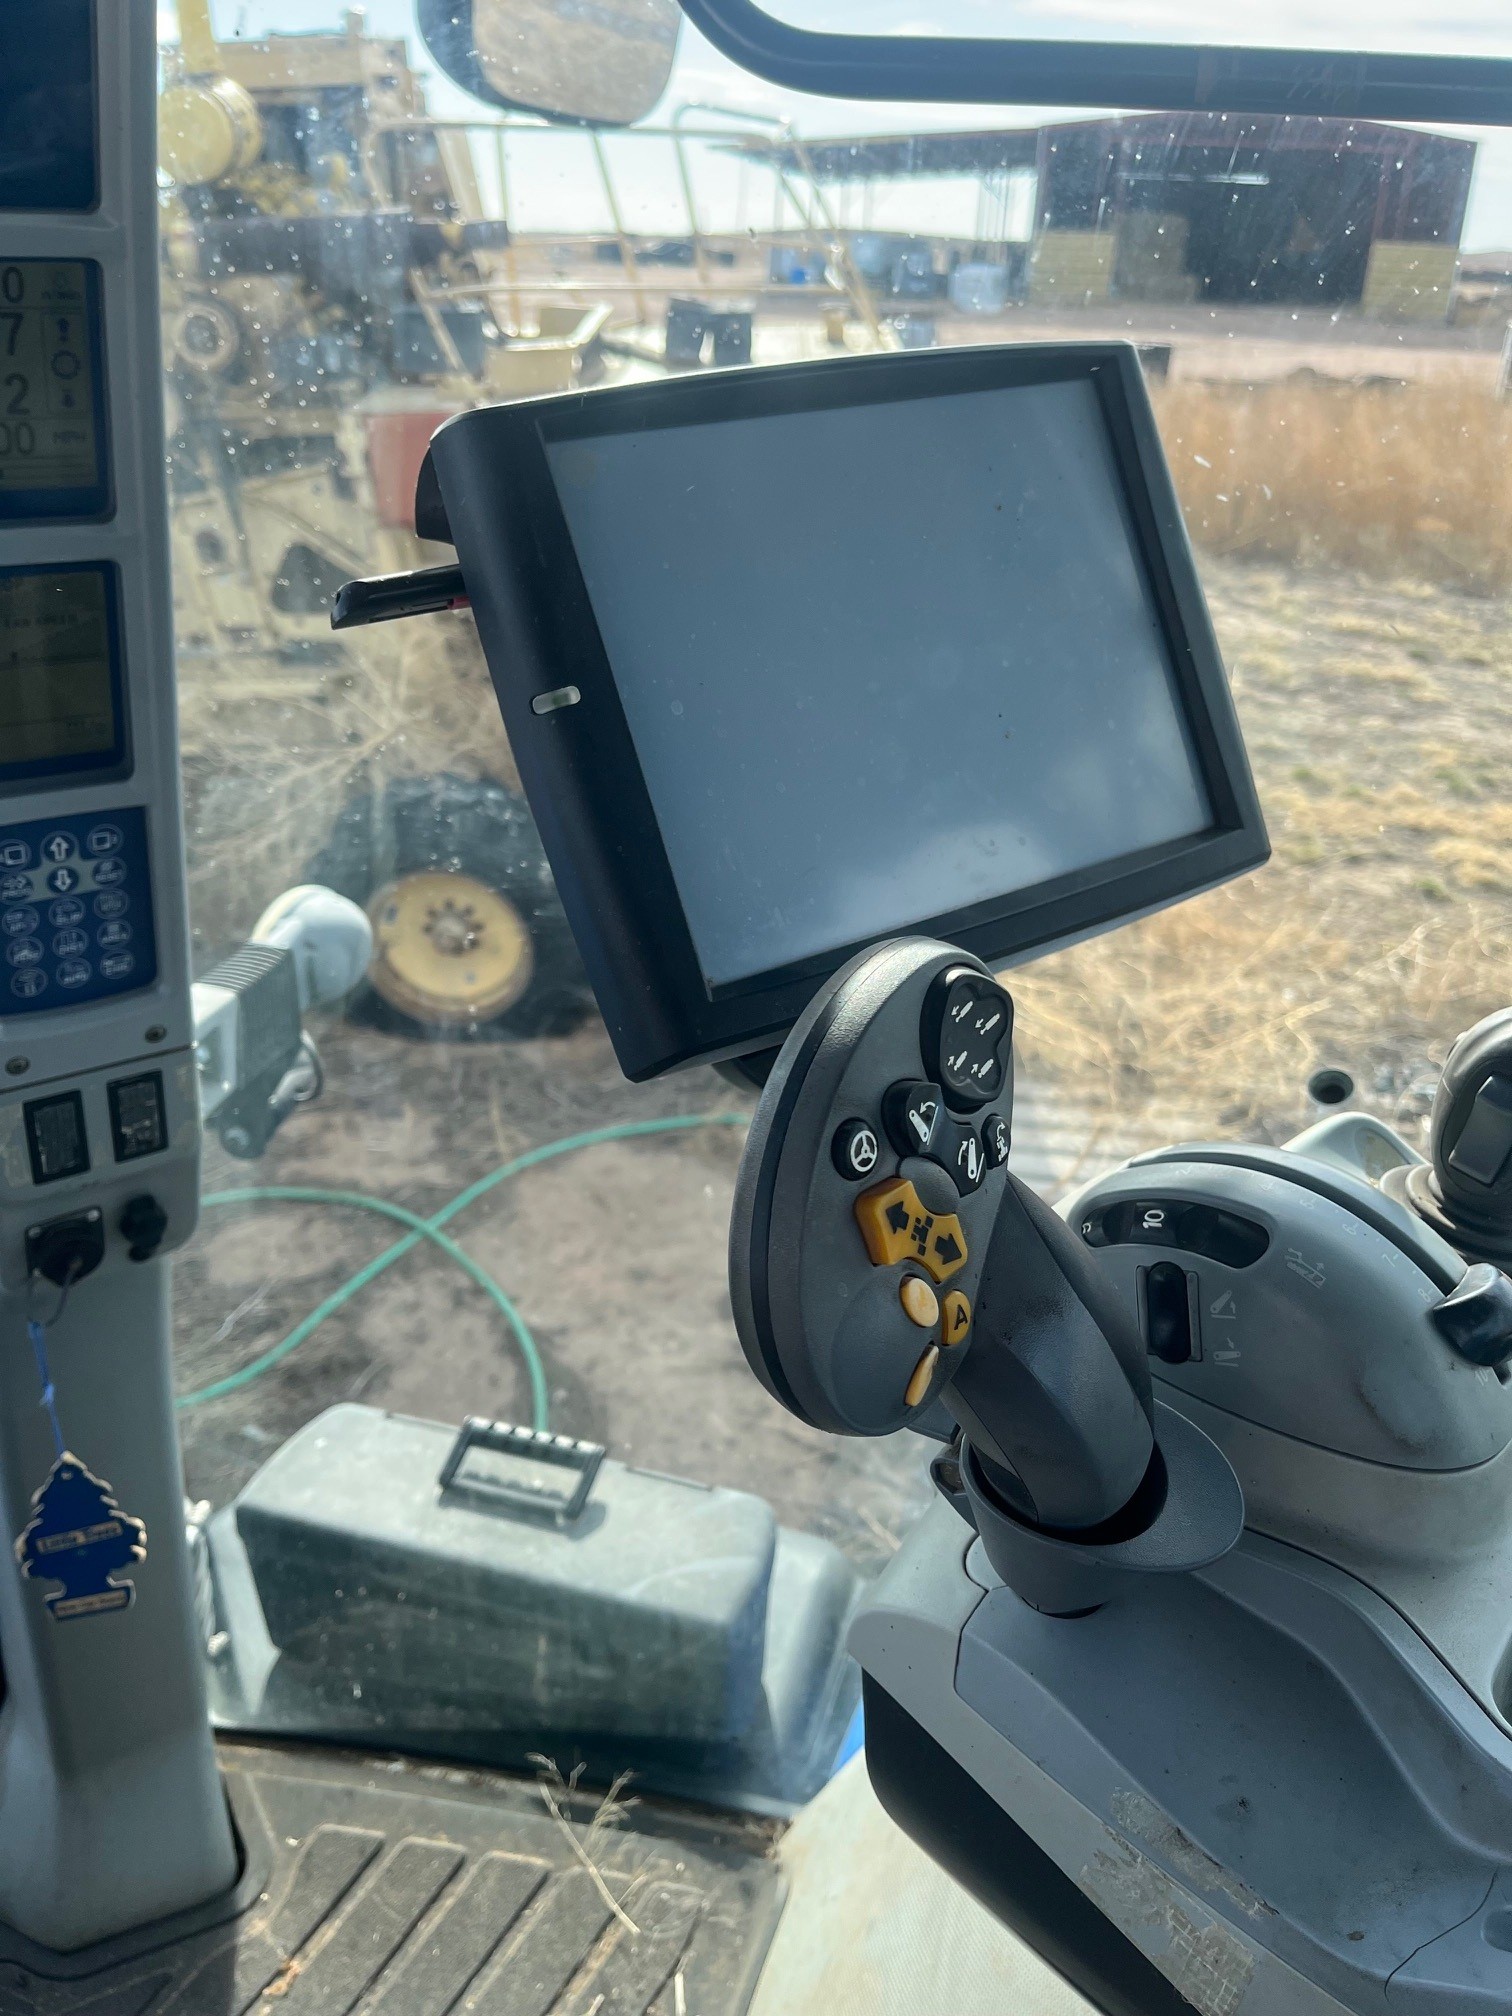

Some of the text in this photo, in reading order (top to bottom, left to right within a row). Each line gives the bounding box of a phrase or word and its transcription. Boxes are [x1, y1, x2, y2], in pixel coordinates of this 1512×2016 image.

[2, 267, 24, 303] 0
[0, 312, 24, 356] 7
[5, 373, 30, 415] 2
[1142, 1209, 1165, 1230] 10
[1381, 1253, 1396, 1268] 7
[1417, 1287, 1432, 1303] 8
[953, 1303, 968, 1331] A
